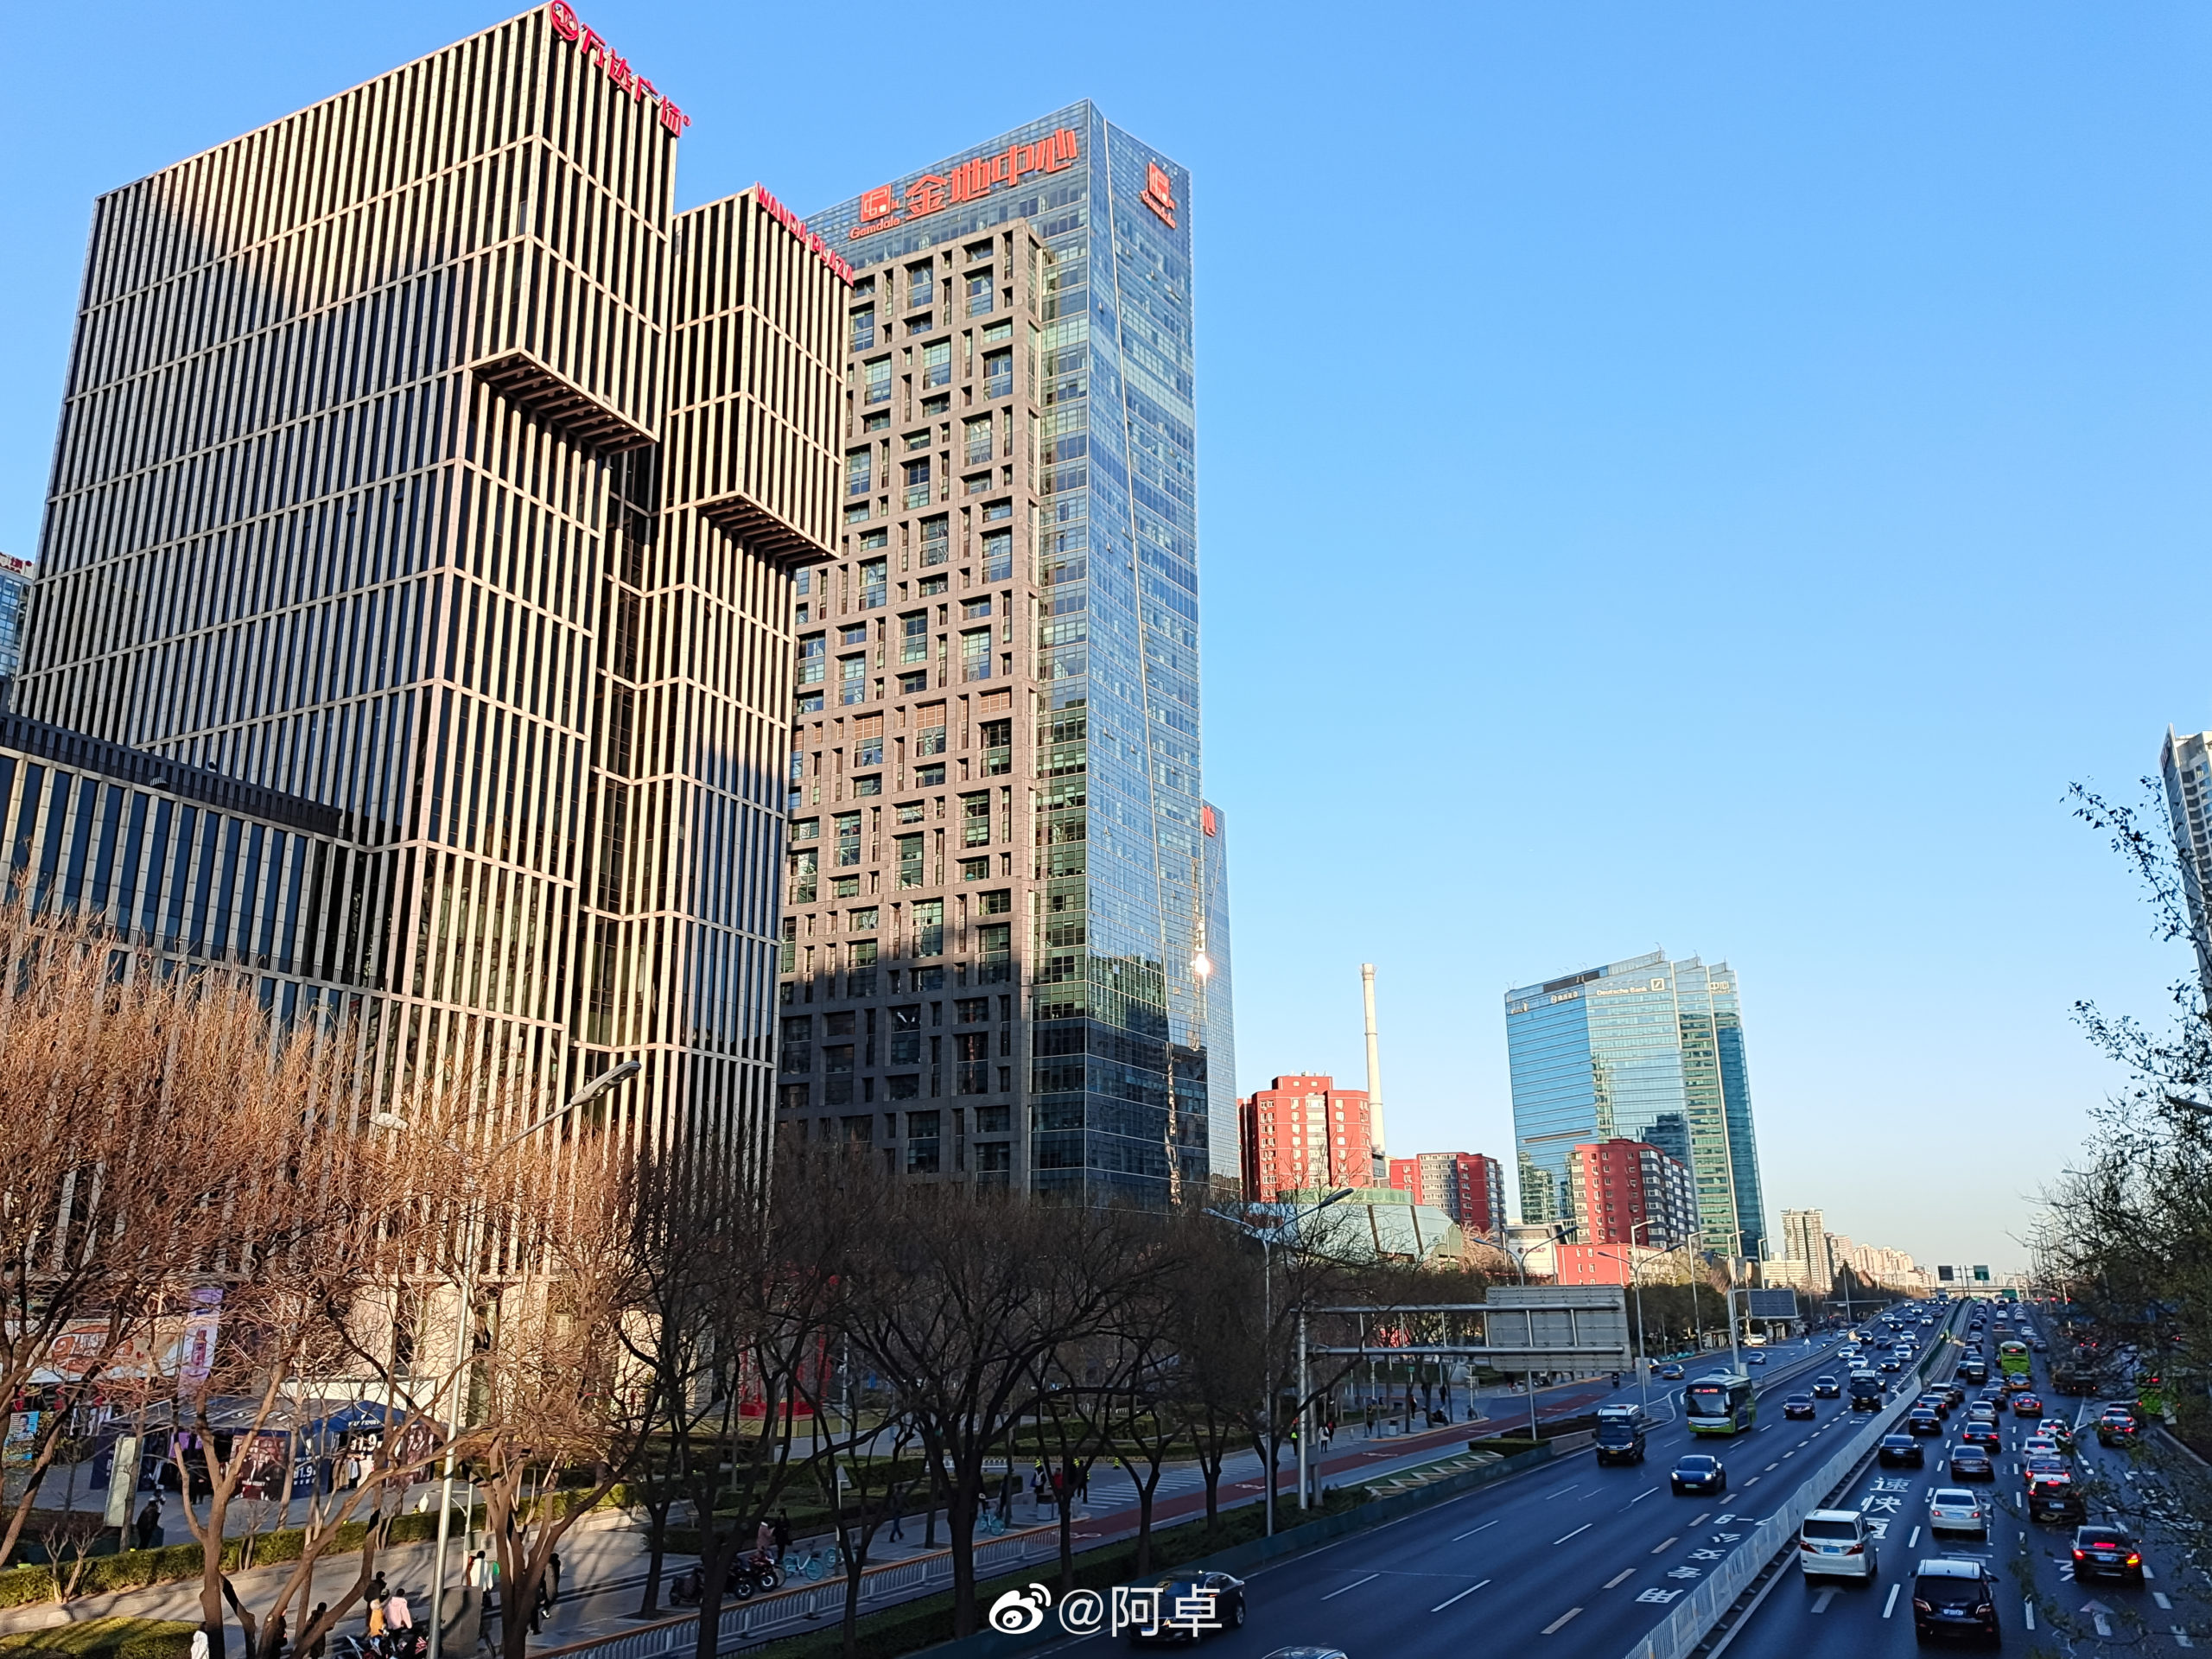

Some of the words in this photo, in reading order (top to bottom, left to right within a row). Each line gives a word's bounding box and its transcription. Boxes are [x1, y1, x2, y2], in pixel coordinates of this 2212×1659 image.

[906, 128, 1077, 219] 金地中心
[755, 182, 807, 244] WANDA
[810, 233, 854, 286] PLAZA
[849, 217, 900, 239] Gemdale
[1141, 190, 1176, 229] Gemdale
